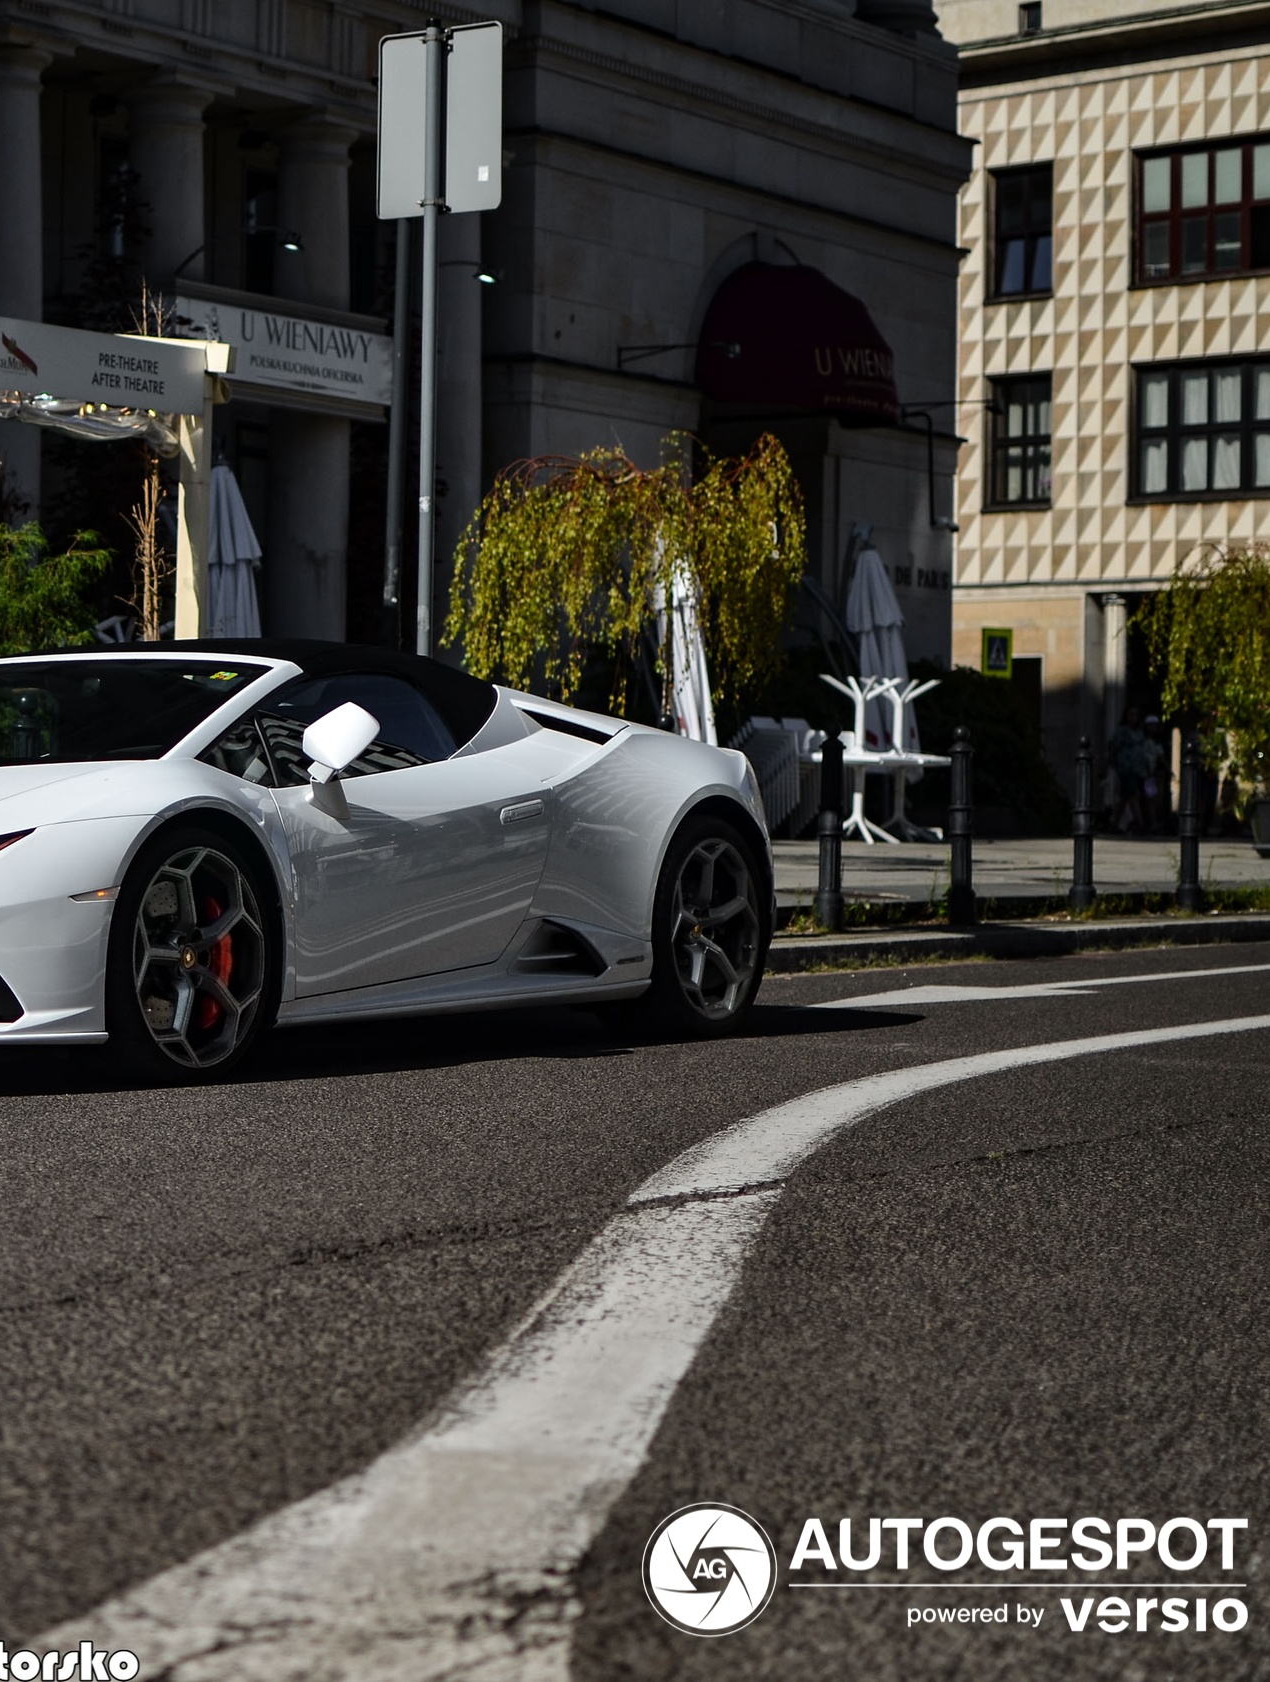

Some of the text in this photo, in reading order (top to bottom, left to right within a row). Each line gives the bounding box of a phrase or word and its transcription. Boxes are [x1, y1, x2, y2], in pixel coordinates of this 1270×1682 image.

[241, 312, 372, 363] U WIENIAWY
[98, 352, 159, 375] PRE-THEATRE
[250, 354, 281, 371] POLSKA
[282, 359, 321, 378] KUCHNIA
[814, 345, 833, 377] U
[91, 372, 165, 395] AFTER THEATRE
[895, 566, 912, 587] DE
